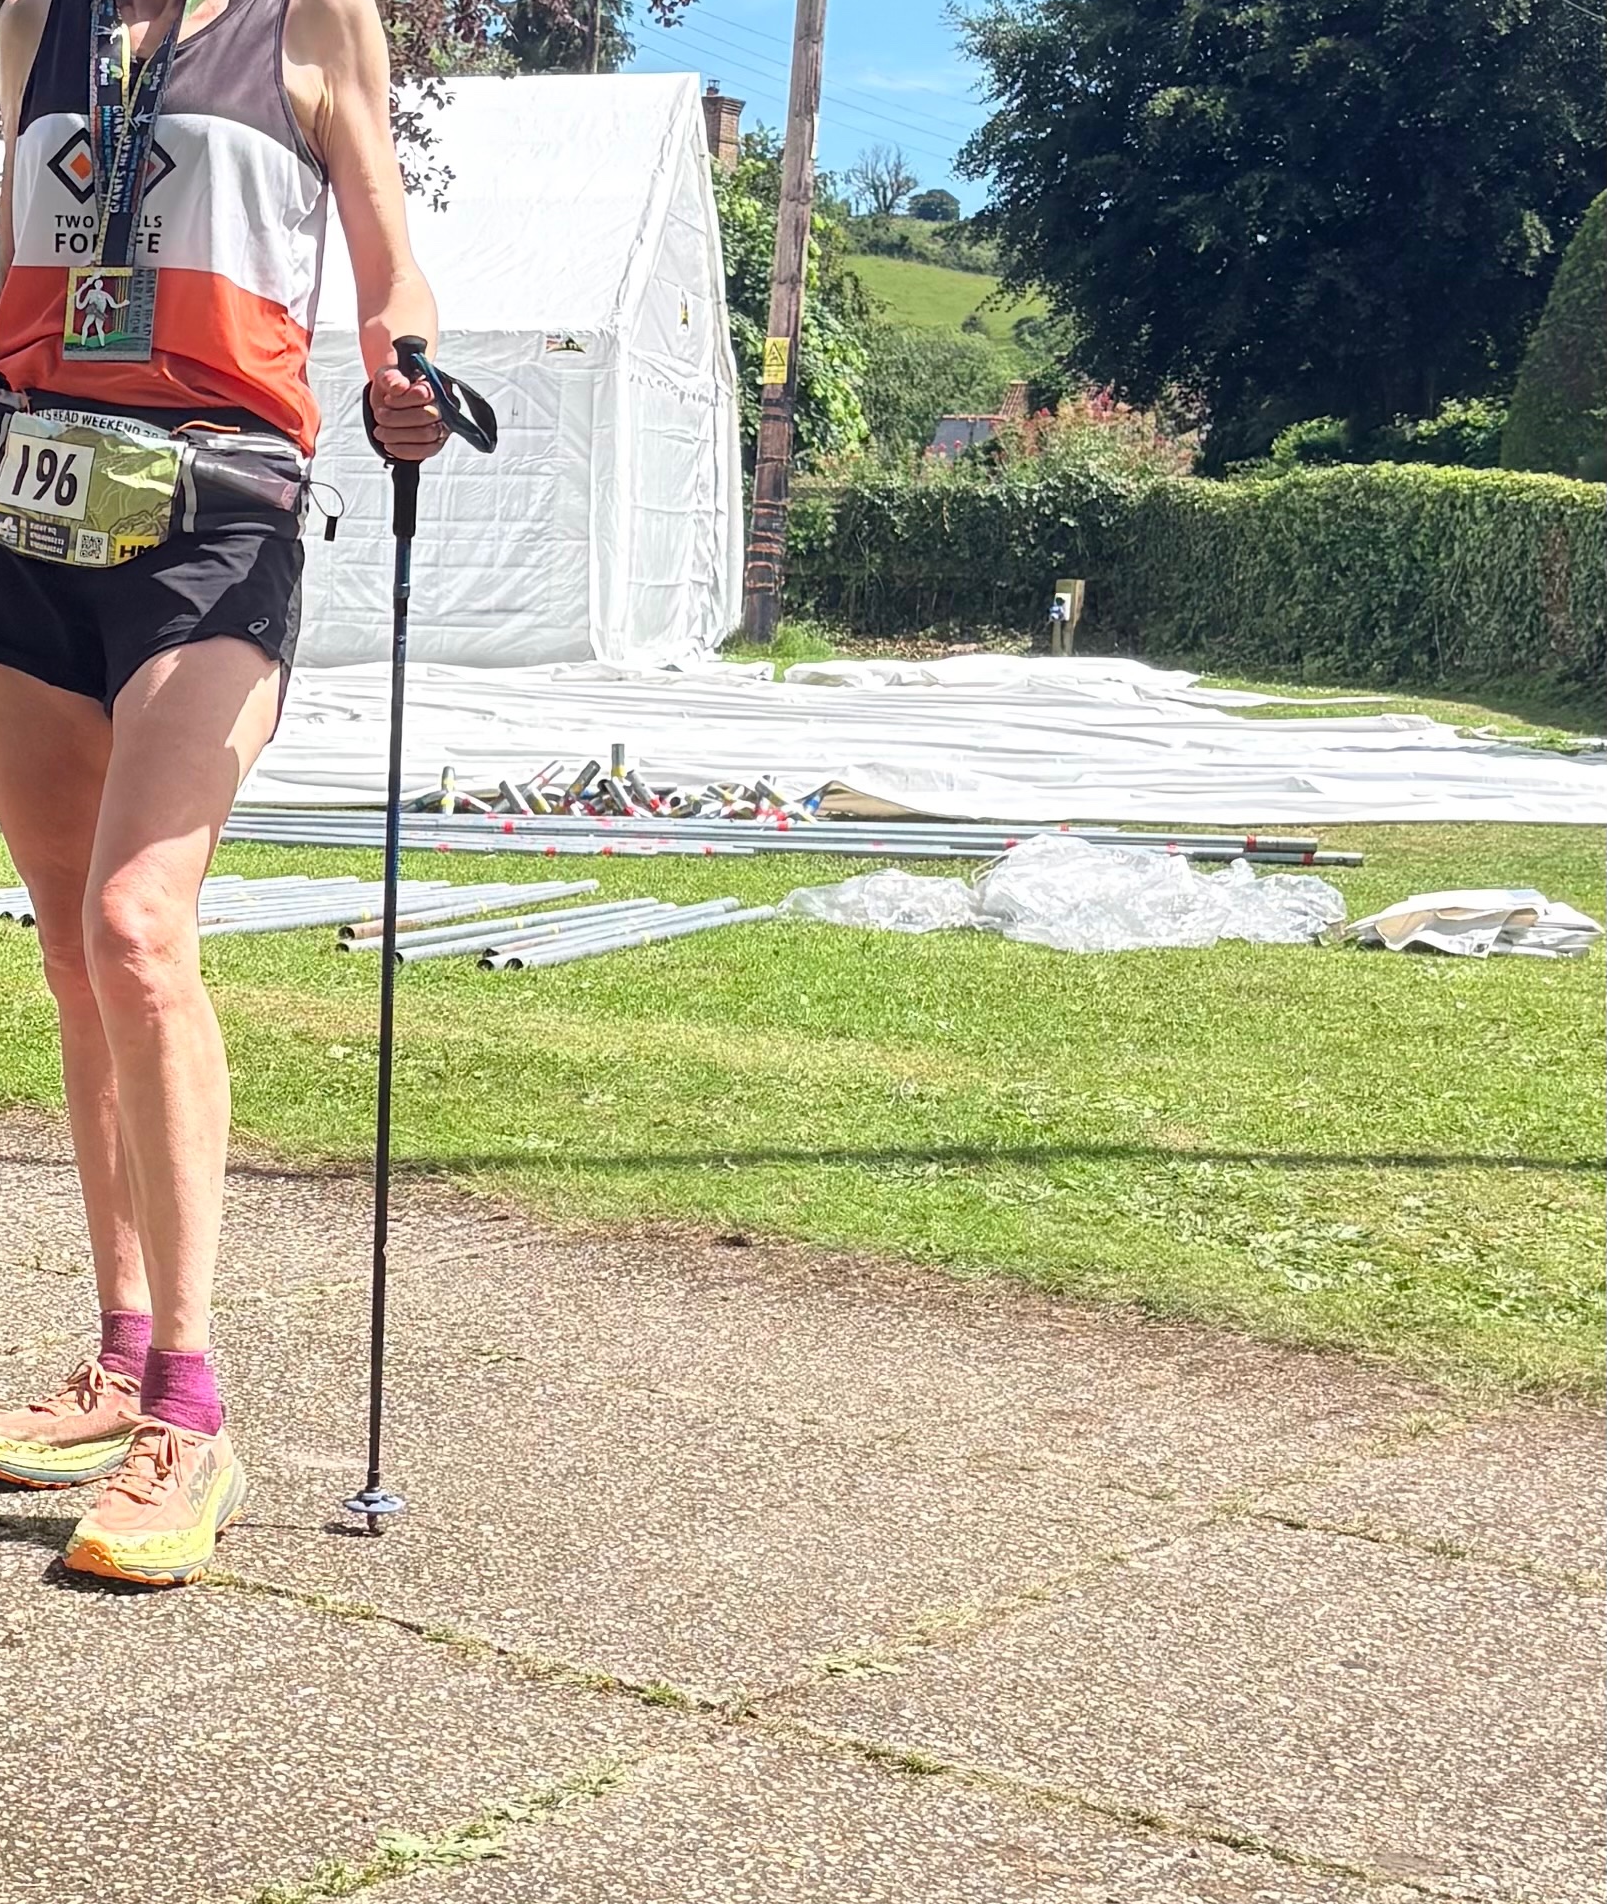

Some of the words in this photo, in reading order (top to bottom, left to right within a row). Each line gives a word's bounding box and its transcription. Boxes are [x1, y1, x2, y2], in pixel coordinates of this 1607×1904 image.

[55, 215, 94, 228] TWO
[81, 414, 141, 435] WEEKEND
[11, 444, 79, 507] 196
